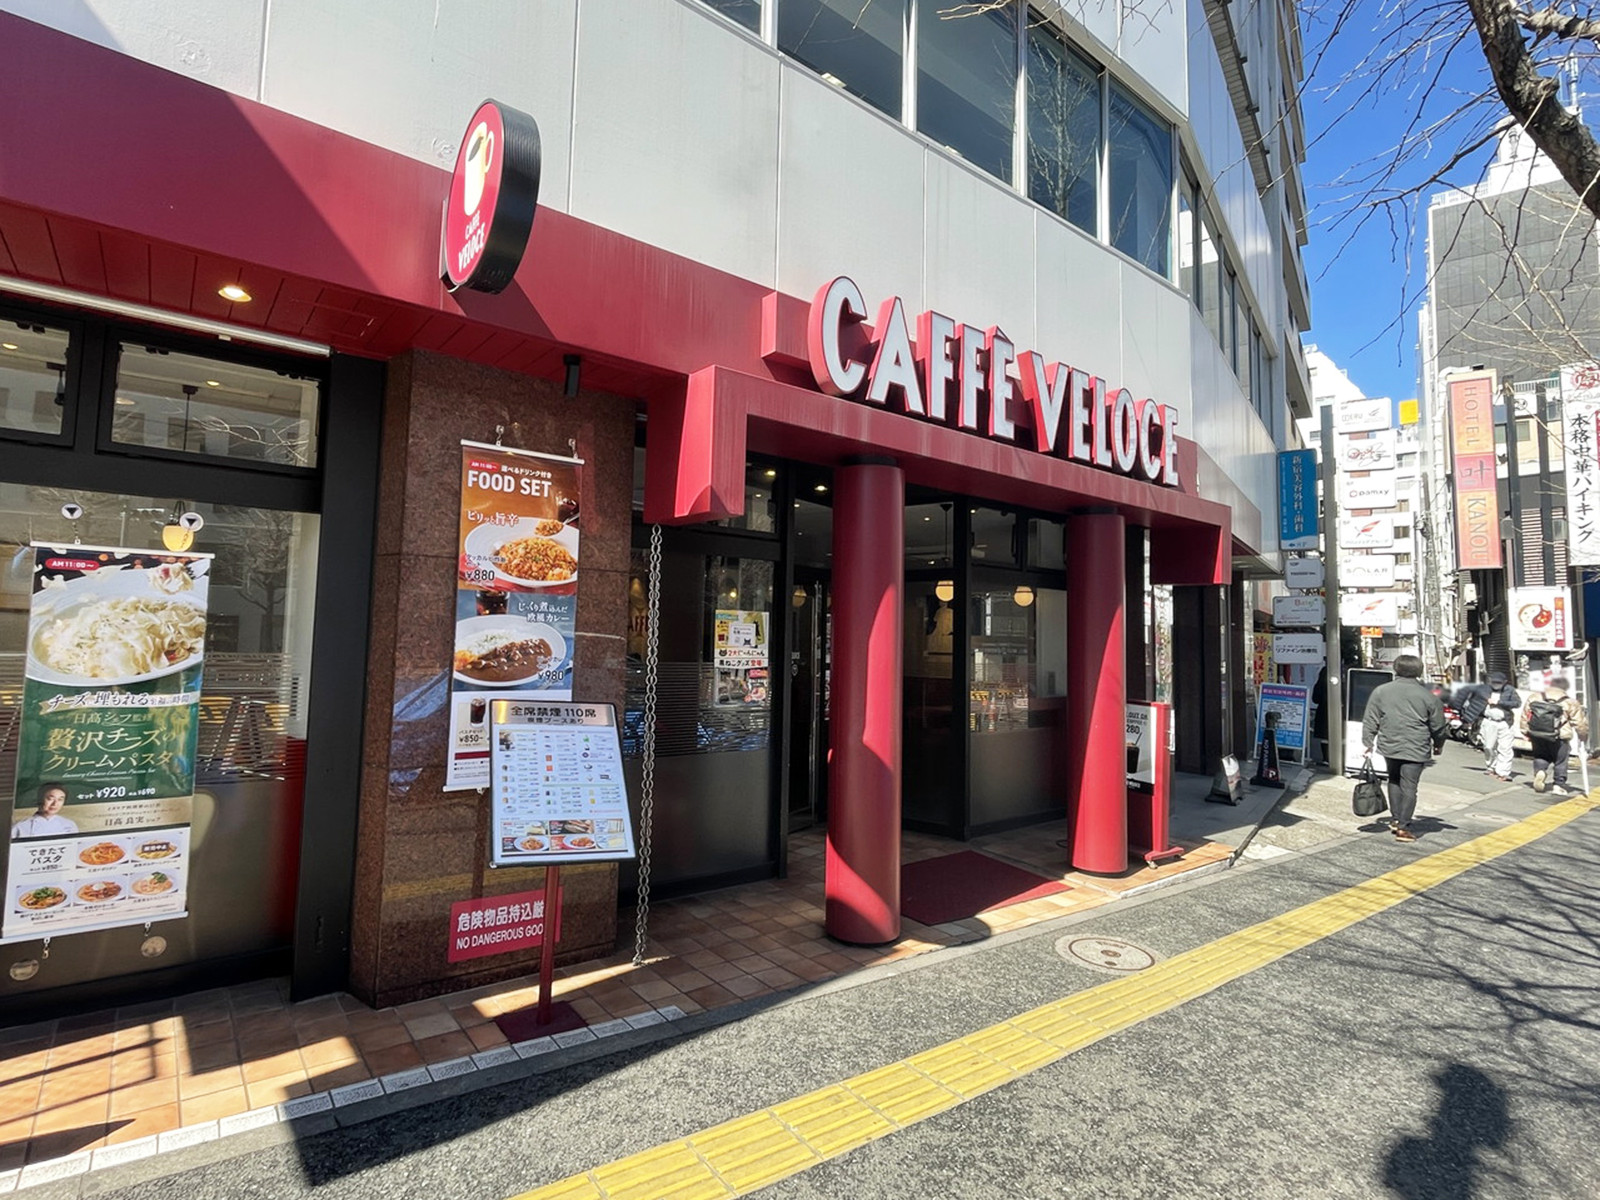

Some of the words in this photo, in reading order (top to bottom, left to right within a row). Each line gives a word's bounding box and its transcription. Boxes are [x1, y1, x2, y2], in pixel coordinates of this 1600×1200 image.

[458, 222, 486, 273] VELOCE
[809, 275, 1016, 441] CAFFÈ
[1017, 349, 1179, 486] VELOCE
[1464, 386, 1479, 446] HOTEL
[467, 469, 516, 493] FOOD
[519, 477, 553, 498] SET
[1570, 413, 1594, 544] 本格中華バイキング
[1467, 497, 1490, 565] KANOU
[51, 560, 64, 568] AM
[466, 569, 495, 581] ¥880
[527, 612, 570, 623] 欧風カレー
[538, 670, 564, 681] ¥980
[510, 705, 562, 717] 全席禁煙
[43, 751, 174, 772] クリームパスタ
[96, 786, 126, 799] ¥920
[29, 847, 66, 857] できたて
[457, 900, 544, 932] 危険物品持込厳
[456, 936, 470, 950] NO
[472, 926, 524, 946] DANGEROUS
